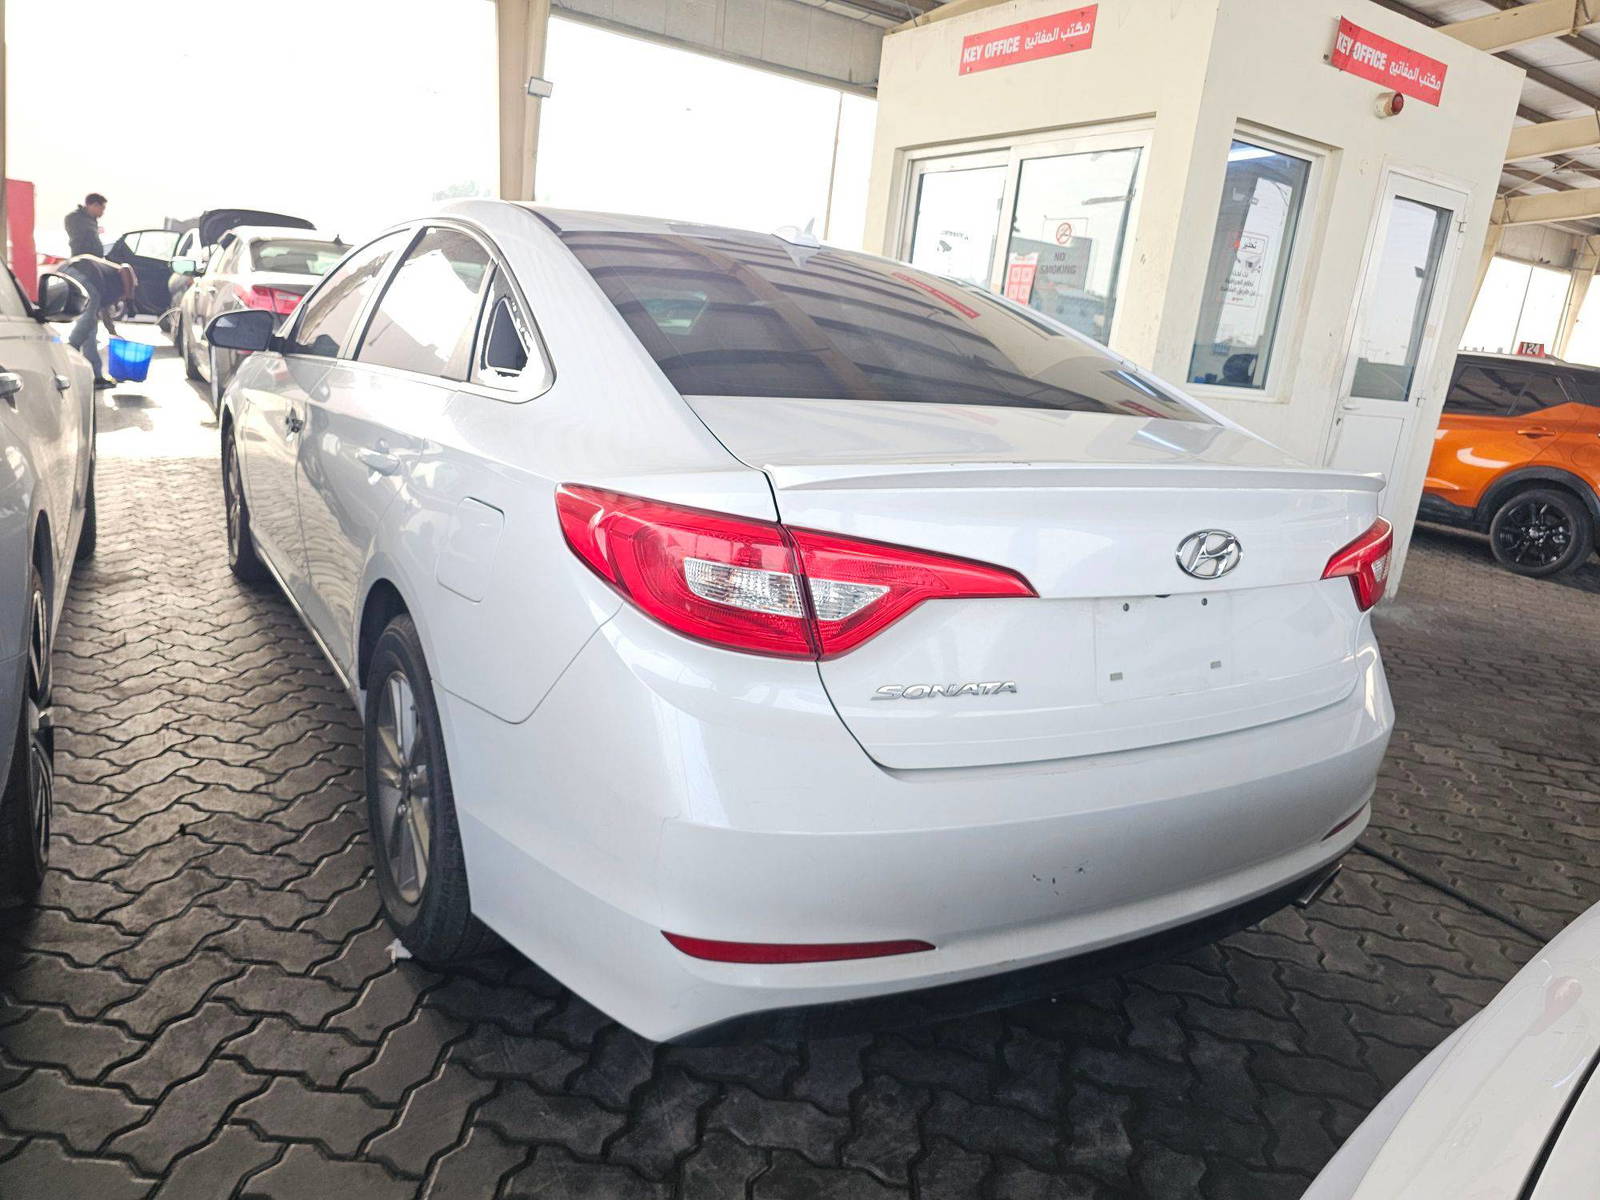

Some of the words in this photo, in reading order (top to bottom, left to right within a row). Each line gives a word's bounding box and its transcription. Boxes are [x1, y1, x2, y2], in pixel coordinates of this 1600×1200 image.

[1024, 27, 1060, 50] المفاتيح
[1061, 22, 1091, 41] مكتب
[963, 46, 984, 63] KEY
[984, 36, 1020, 58] OFFICE
[1336, 31, 1354, 56] KEY
[1352, 42, 1388, 71] OFFICE
[1389, 61, 1420, 80] المفاتيح
[1420, 72, 1441, 90] مكتب
[1055, 252, 1066, 262] NO
[1040, 264, 1077, 275] SMOKING
[1522, 343, 1540, 355] 124
[870, 680, 1018, 701] SONATA
